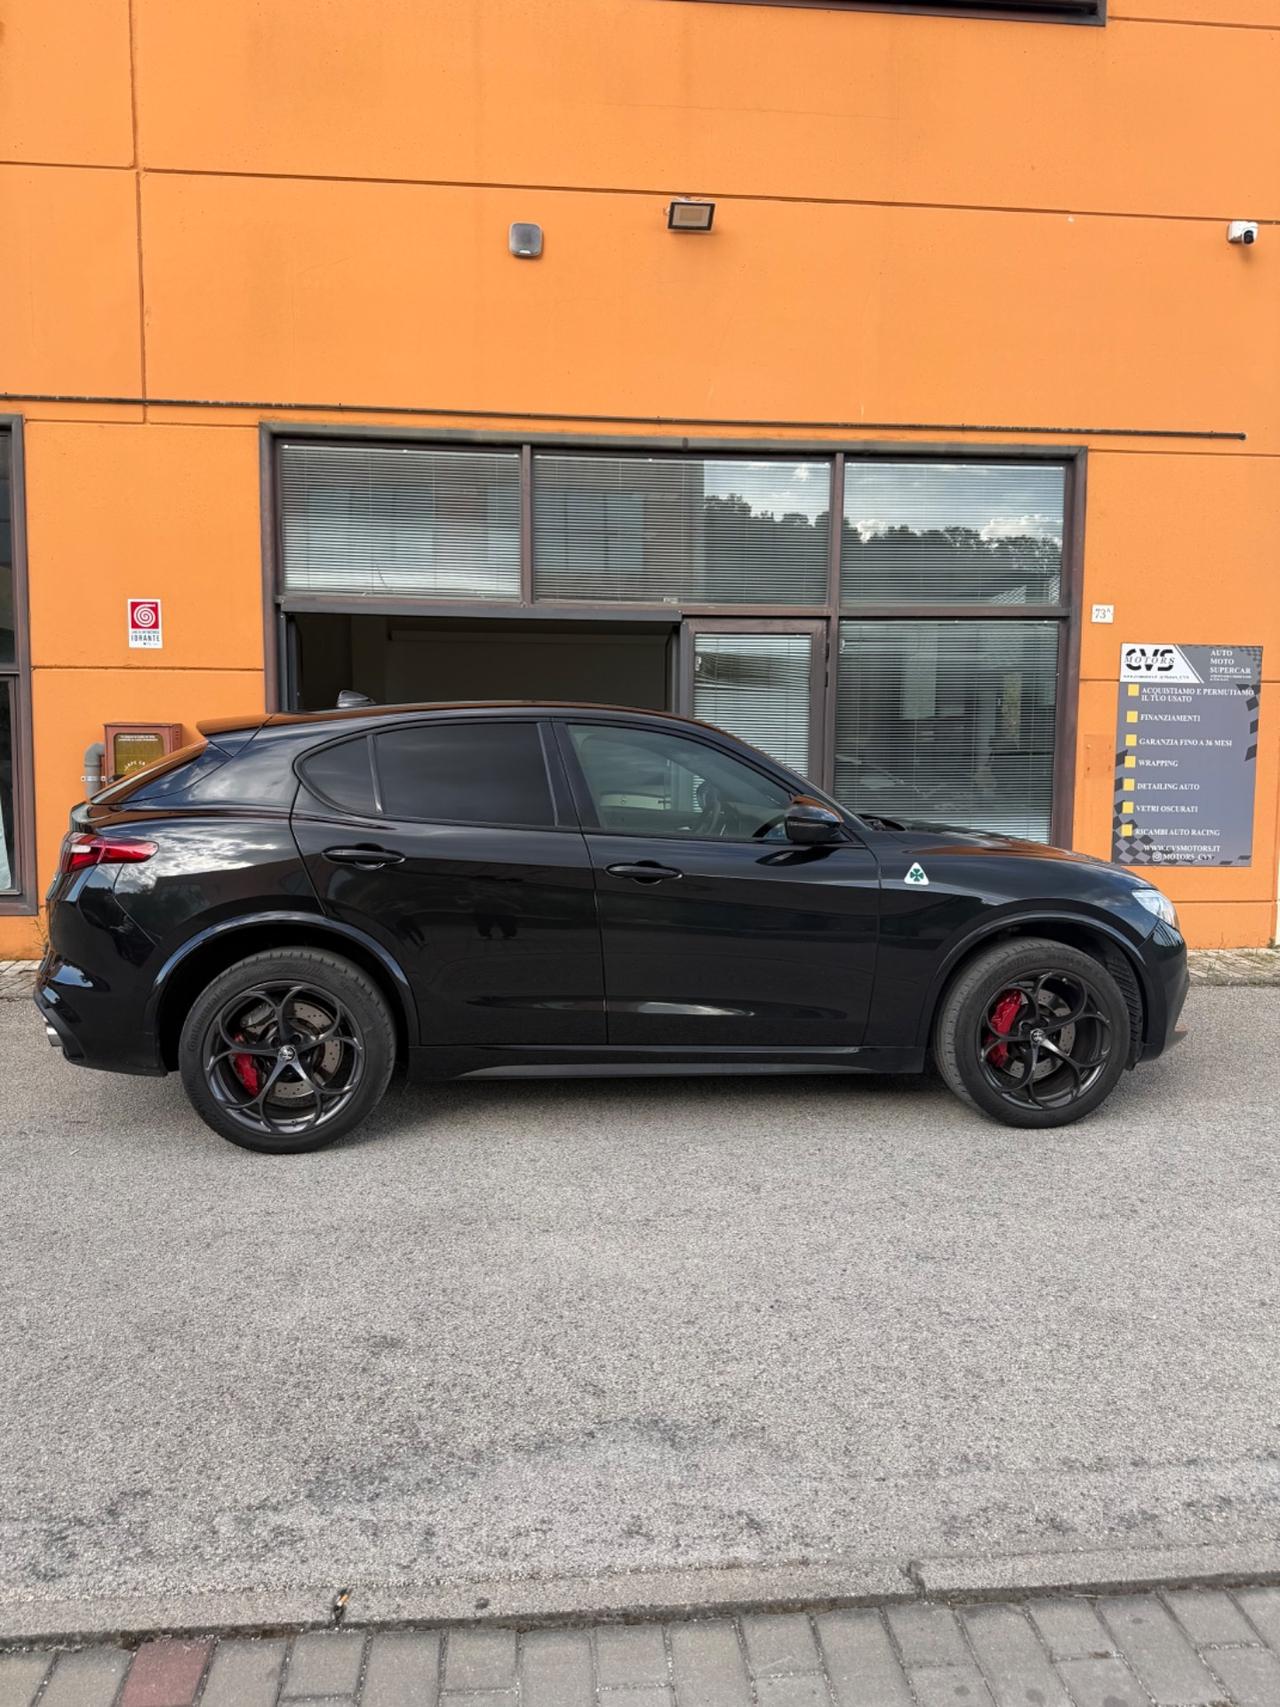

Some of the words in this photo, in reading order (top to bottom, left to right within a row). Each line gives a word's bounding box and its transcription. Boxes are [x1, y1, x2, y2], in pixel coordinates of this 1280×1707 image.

[131, 634, 160, 642] IDRANTE
[1124, 656, 1175, 664] MOTORS
[1126, 648, 1174, 671] CVS
[1142, 687, 1195, 696] ACQUISTIAMO
[1203, 688, 1254, 696] PERMUTIAMO
[1150, 694, 1166, 702] TUO
[1140, 714, 1201, 722] FINANZIAMENTI
[1139, 738, 1178, 746] GARANZIA
[1135, 828, 1168, 836] RICAMBI
[1169, 828, 1190, 836] AUTO
